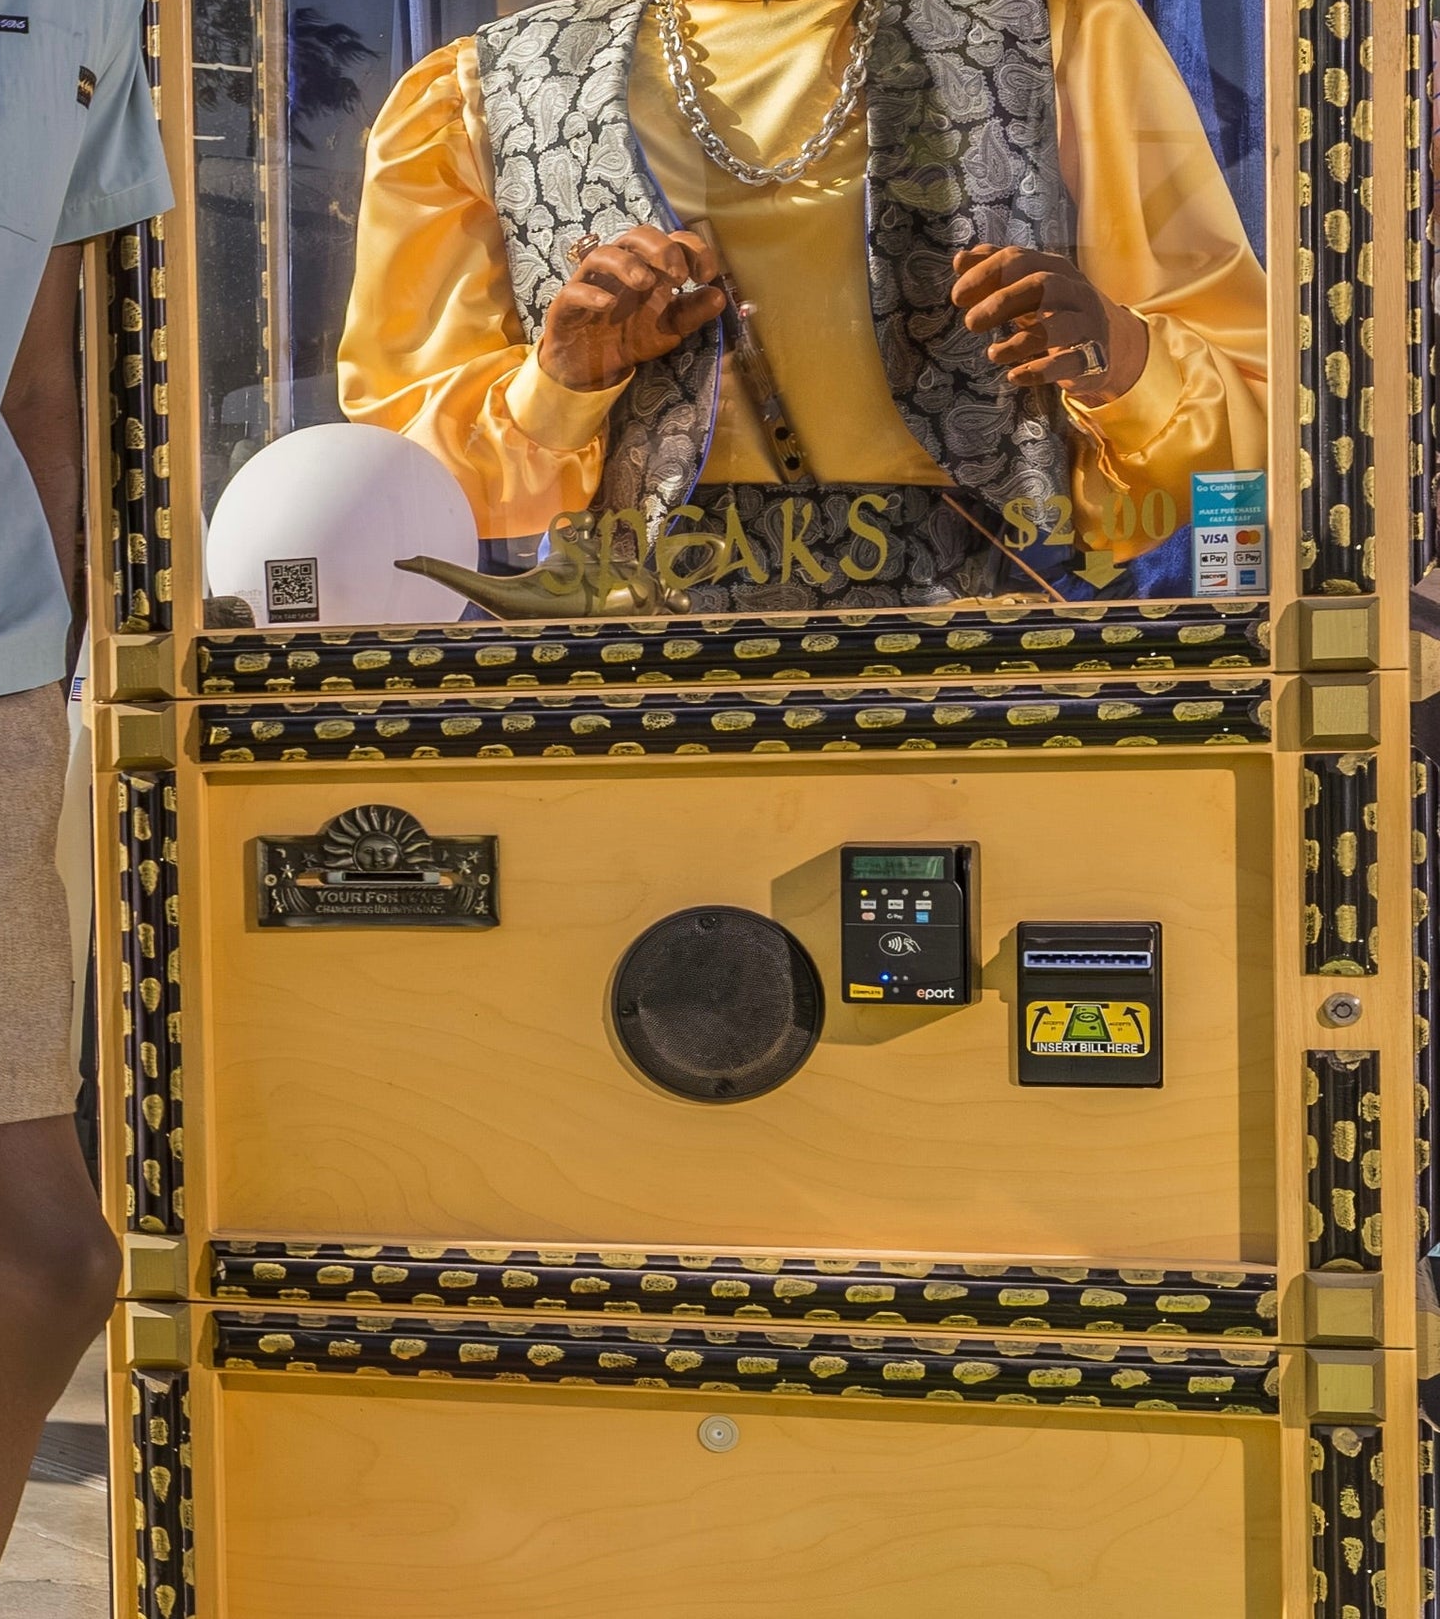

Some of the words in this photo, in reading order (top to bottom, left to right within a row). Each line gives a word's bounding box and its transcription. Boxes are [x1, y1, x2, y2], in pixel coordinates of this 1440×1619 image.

[1209, 484, 1245, 492] Cashless
[1220, 506, 1261, 514] PURCHASES
[1002, 488, 1178, 551] $2.00
[1200, 533, 1229, 544] VISA
[538, 493, 889, 614] SPEAKS
[315, 891, 361, 904] YOUR
[365, 890, 447, 904] FORTUNE
[315, 904, 373, 915] CHARACTERS
[916, 987, 955, 1000] eport
[1036, 1042, 1077, 1053] INSERT
[1080, 1043, 1105, 1053] BILL
[1107, 1043, 1139, 1054] HERE
